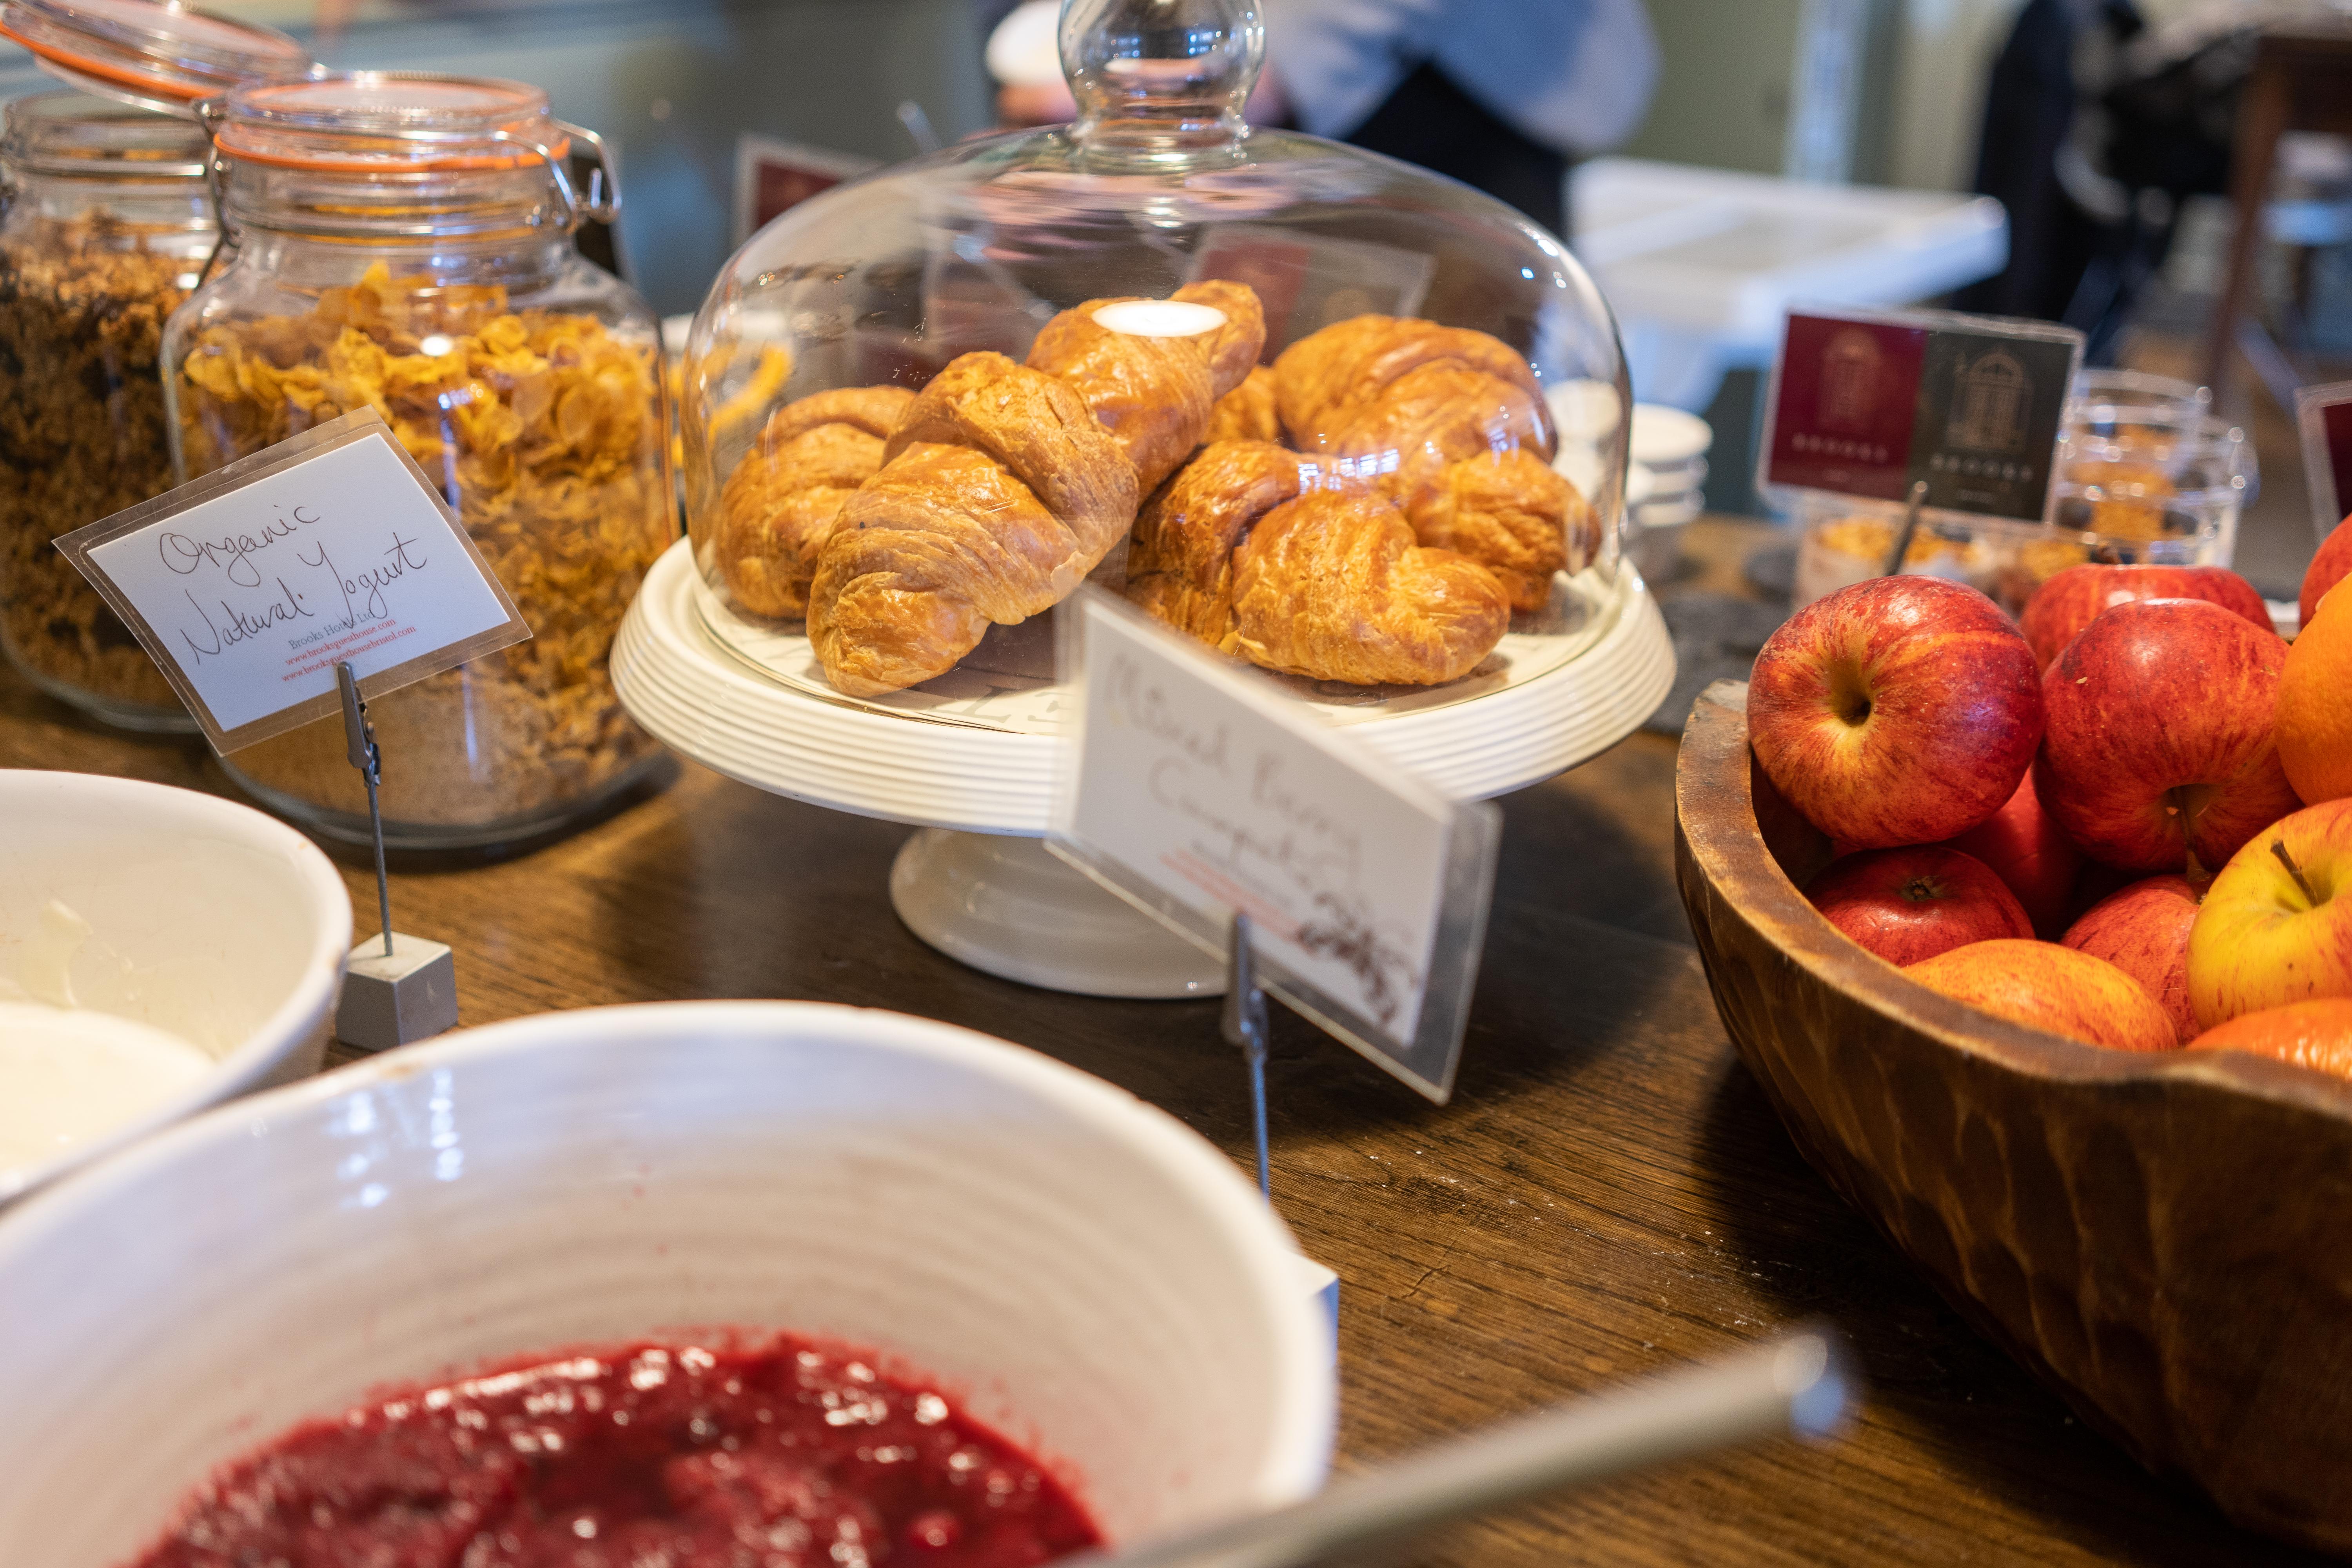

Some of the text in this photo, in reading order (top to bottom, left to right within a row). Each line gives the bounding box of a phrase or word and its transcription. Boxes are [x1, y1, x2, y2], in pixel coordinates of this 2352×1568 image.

[160, 505, 320, 587] Organic
[180, 533, 427, 665] Natural Yogurt
[281, 626, 417, 682] www.brooksguesthousebristol.com
[285, 619, 396, 665] www.brooksguesthouse.com
[288, 630, 324, 650] Brooks
